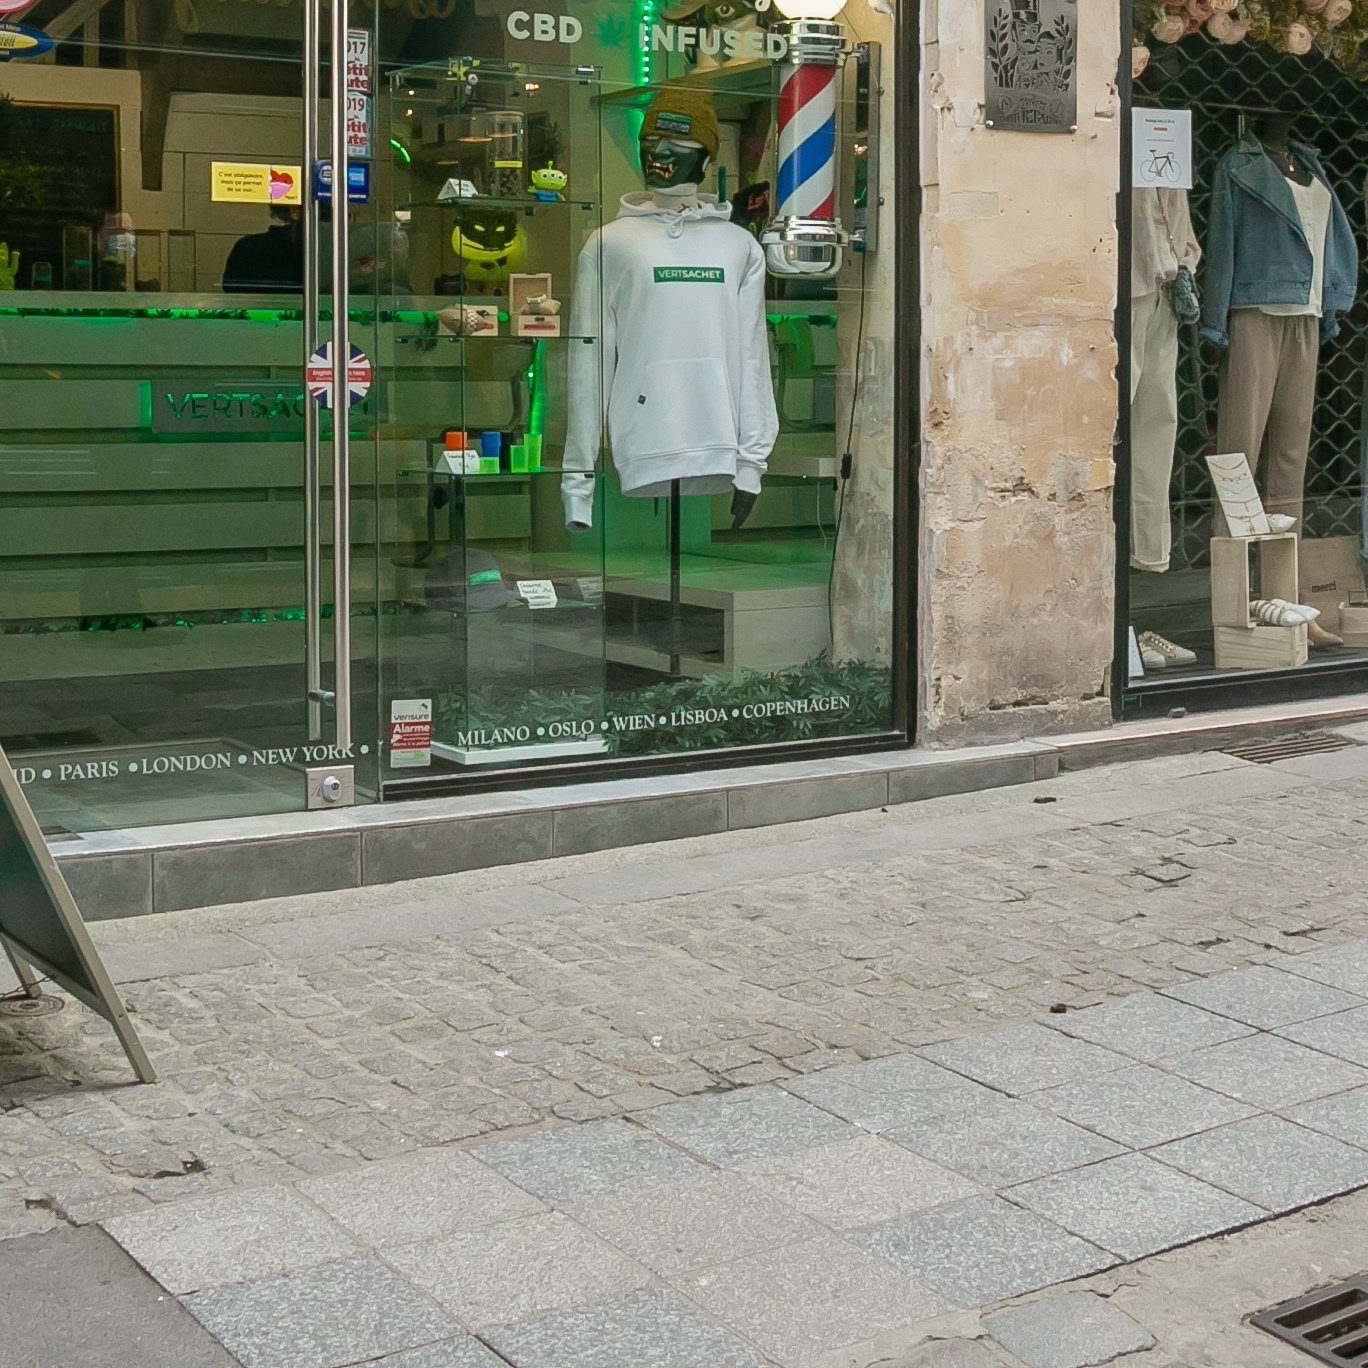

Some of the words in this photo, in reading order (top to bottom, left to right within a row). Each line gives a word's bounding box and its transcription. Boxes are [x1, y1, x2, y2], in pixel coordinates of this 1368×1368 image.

[506, 10, 583, 44] CBD
[638, 23, 789, 60] INFUSED
[657, 269, 721, 279] VERTSACHET
[393, 723, 430, 733] Alarme
[457, 726, 530, 746] MILANO
[549, 719, 595, 737] OSLO
[612, 713, 656, 732] WIEN
[671, 707, 728, 727] LISBOA
[742, 695, 851, 718] COPENHAGEN
[59, 760, 119, 781] PARIS
[141, 752, 231, 774] LONDON
[252, 746, 300, 766] NEW
[301, 743, 355, 763] YORK
